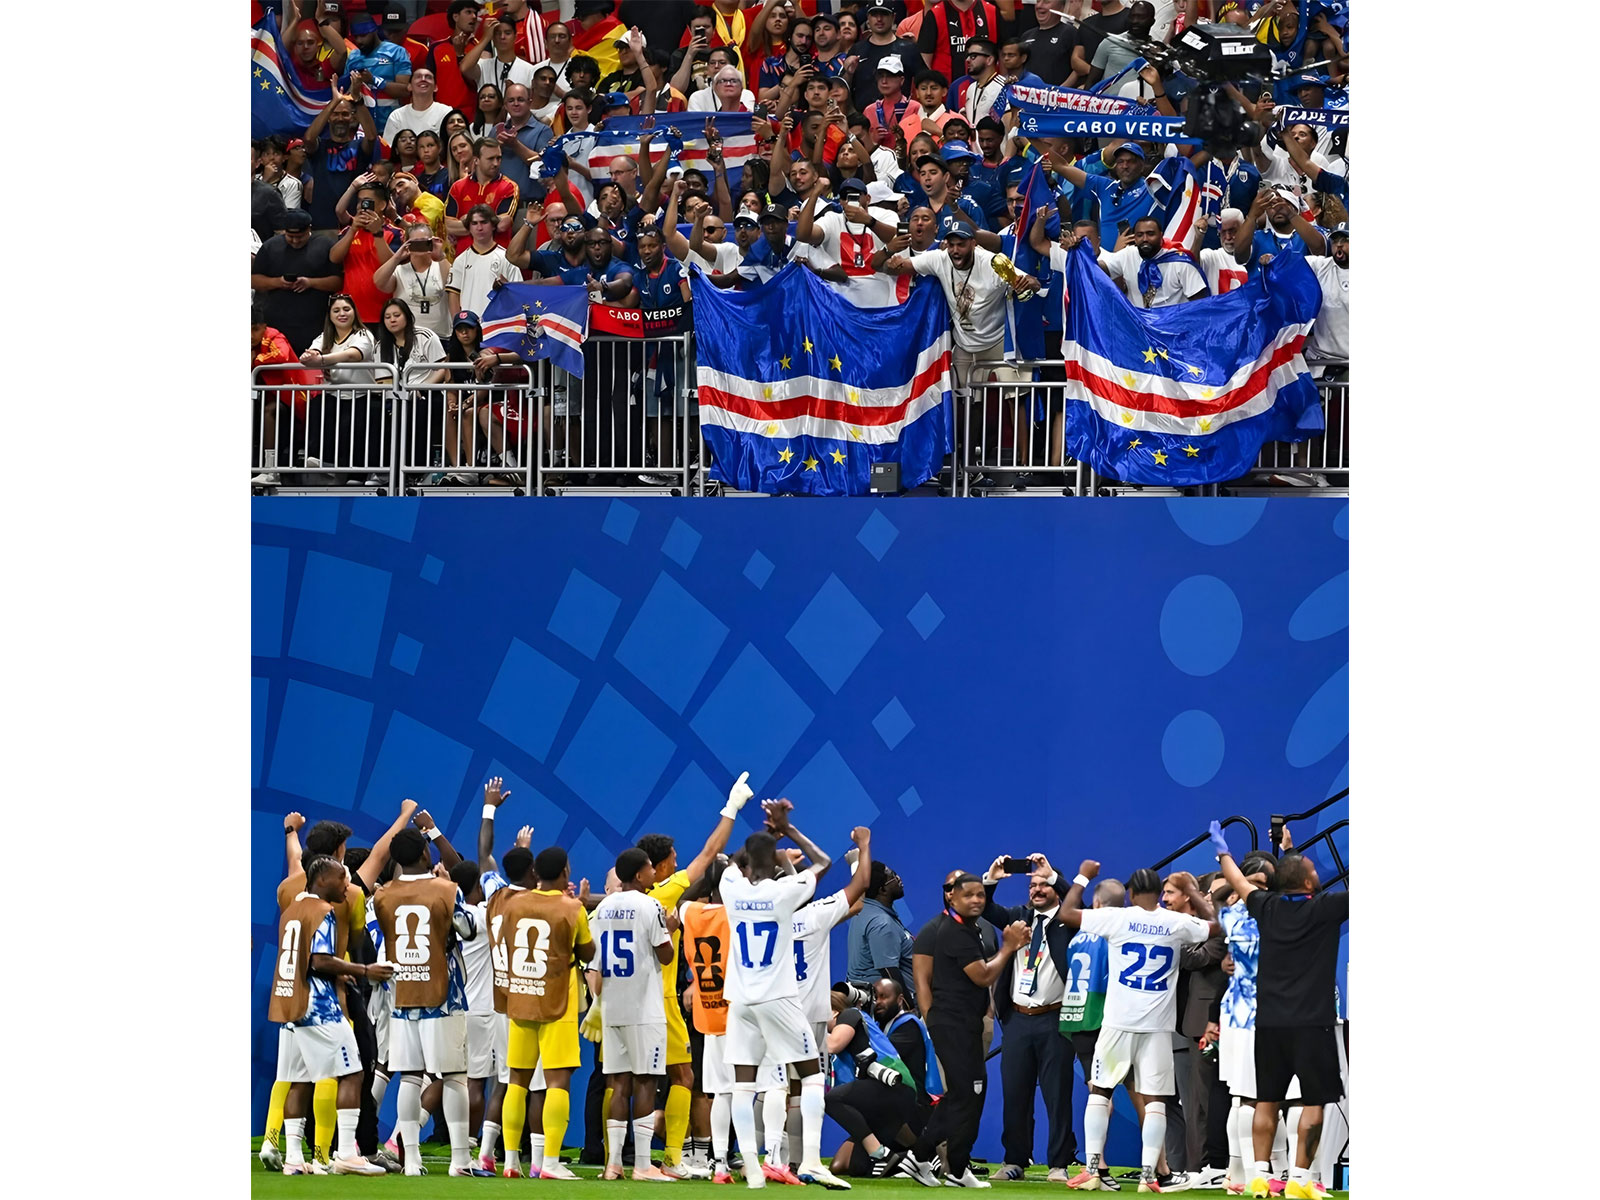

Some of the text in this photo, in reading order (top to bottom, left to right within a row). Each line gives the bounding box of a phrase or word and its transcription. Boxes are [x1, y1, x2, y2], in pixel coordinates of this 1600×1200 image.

[1016, 84, 1057, 106] CABO
[1066, 94, 1128, 115] VERDE
[1064, 121, 1117, 135] CABO
[608, 306, 682, 321] CABO VERDE
[600, 930, 635, 978] 15
[736, 920, 779, 969] 17
[1118, 942, 1174, 992] 22
